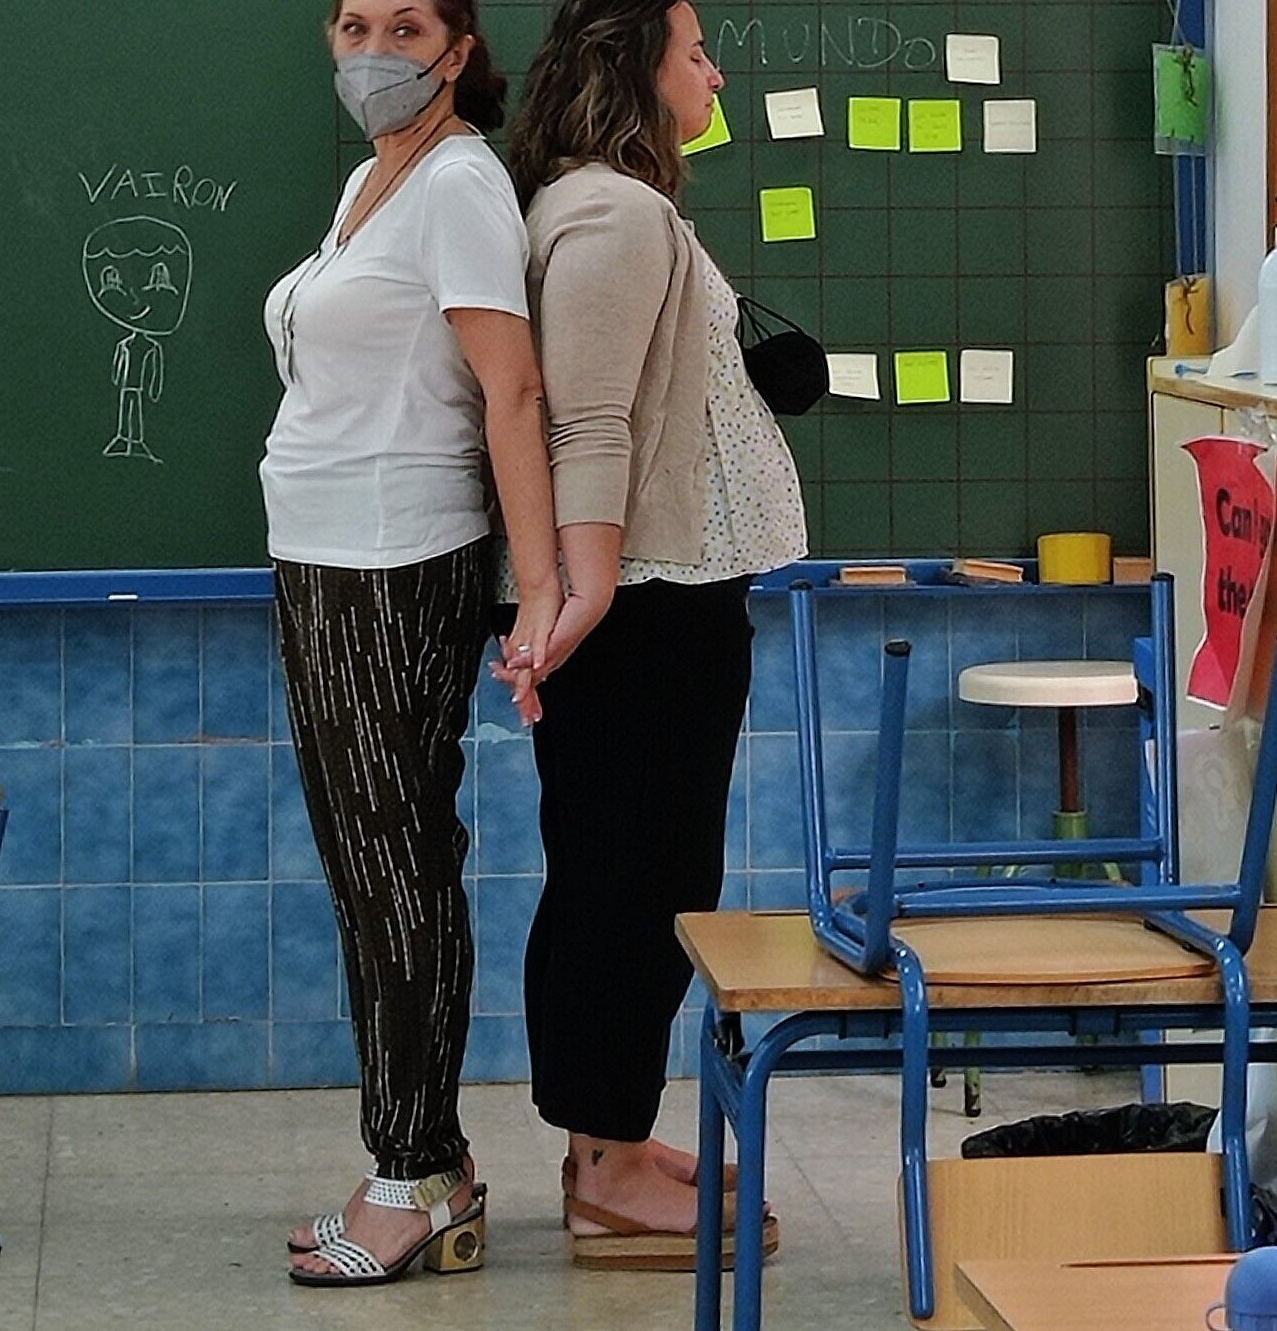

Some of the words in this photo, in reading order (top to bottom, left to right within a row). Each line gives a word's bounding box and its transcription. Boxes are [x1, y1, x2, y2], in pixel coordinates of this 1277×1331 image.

[714, 17, 937, 70] MUNDO
[79, 163, 238, 212] VAIRON
[1215, 487, 1252, 544] Can
[1217, 565, 1247, 619] the
